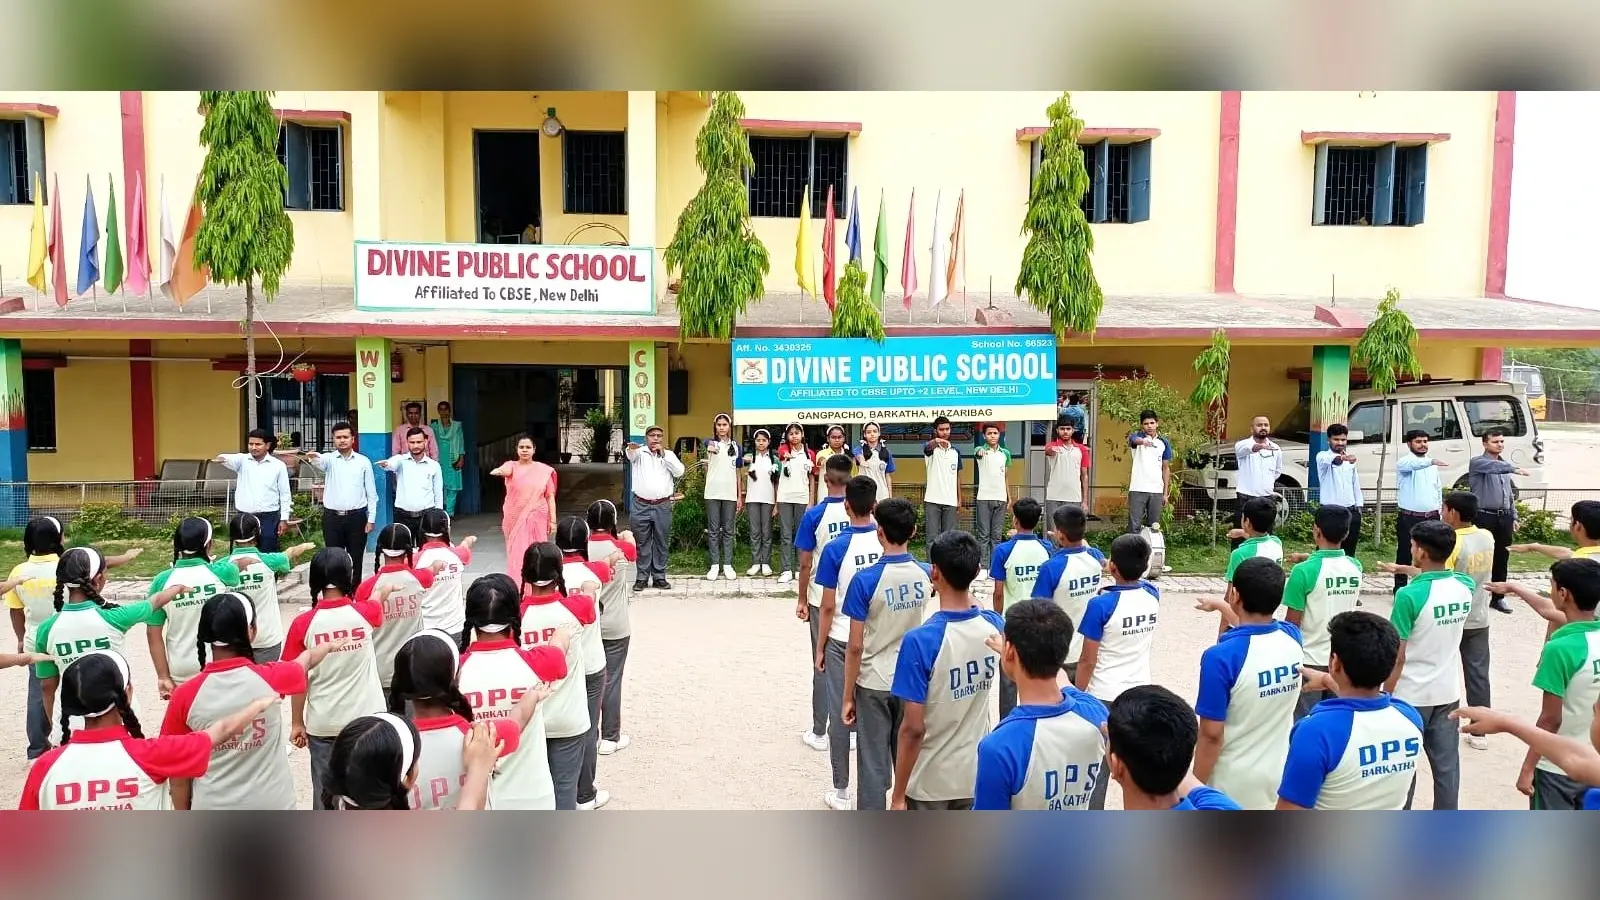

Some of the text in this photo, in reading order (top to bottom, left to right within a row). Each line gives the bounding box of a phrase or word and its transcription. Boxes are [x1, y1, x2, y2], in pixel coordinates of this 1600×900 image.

[367, 248, 646, 283] DIVINE PUBLIC SCHOOL
[415, 285, 599, 304] Affiliated To CBSE, New Delhi
[735, 343, 752, 352] Aff.
[755, 343, 770, 352] No.
[971, 339, 1006, 349] School
[1007, 340, 1023, 348] No.
[771, 355, 852, 385] DIVINE
[860, 353, 948, 383] PUBLIC
[956, 352, 1054, 382] SCHOOL
[790, 385, 1019, 397] AFFILIATED TO CBSE UPTO +2 LEVEL, NEW DELHI
[797, 408, 993, 420] GANGPACHO, BARKATHA, HAZARIBAG
[855, 553, 879, 566] DP
[240, 573, 264, 585] PS
[1069, 573, 1100, 591] DPS
[1326, 576, 1359, 588] DPS
[885, 581, 925, 606] DPS
[382, 594, 418, 615] DPS
[1433, 601, 1470, 619] DPS
[1122, 613, 1157, 629] DPS
[55, 636, 111, 657] DPS
[949, 655, 995, 691] DPS
[1258, 661, 1300, 689] DPS
[1358, 736, 1419, 767] DPS
[1045, 762, 1100, 801] DPS
[55, 777, 139, 806] DPS
